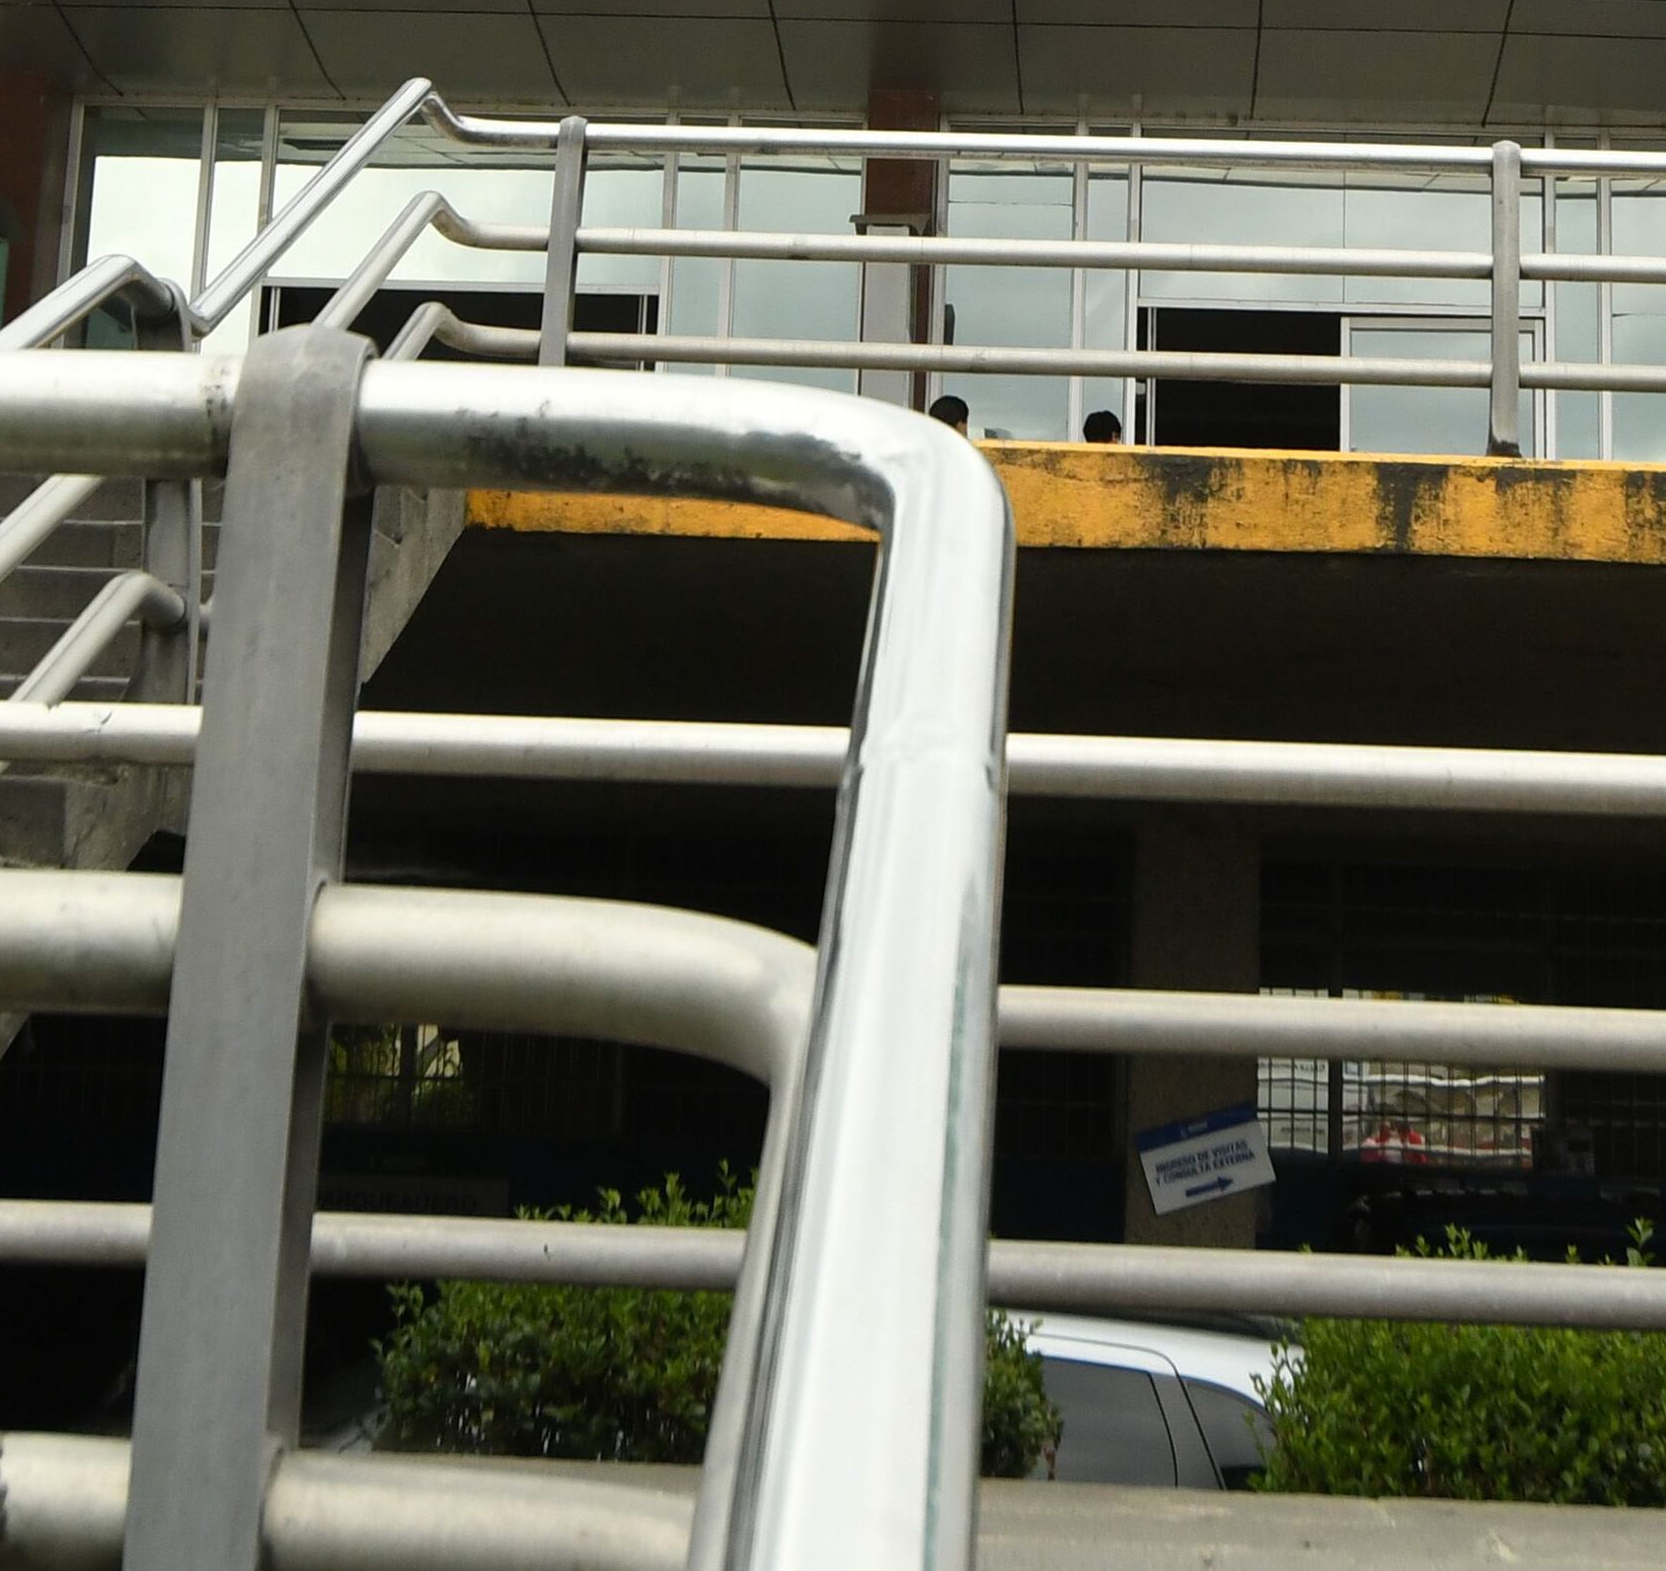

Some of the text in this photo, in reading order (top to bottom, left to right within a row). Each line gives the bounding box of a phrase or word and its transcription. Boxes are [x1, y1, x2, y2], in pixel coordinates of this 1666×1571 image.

[1197, 1150, 1209, 1162] DE
[1212, 1139, 1248, 1158] VISITAS
[1163, 1161, 1211, 1184] CONSULTA
[1213, 1148, 1255, 1170] EXTERNA
